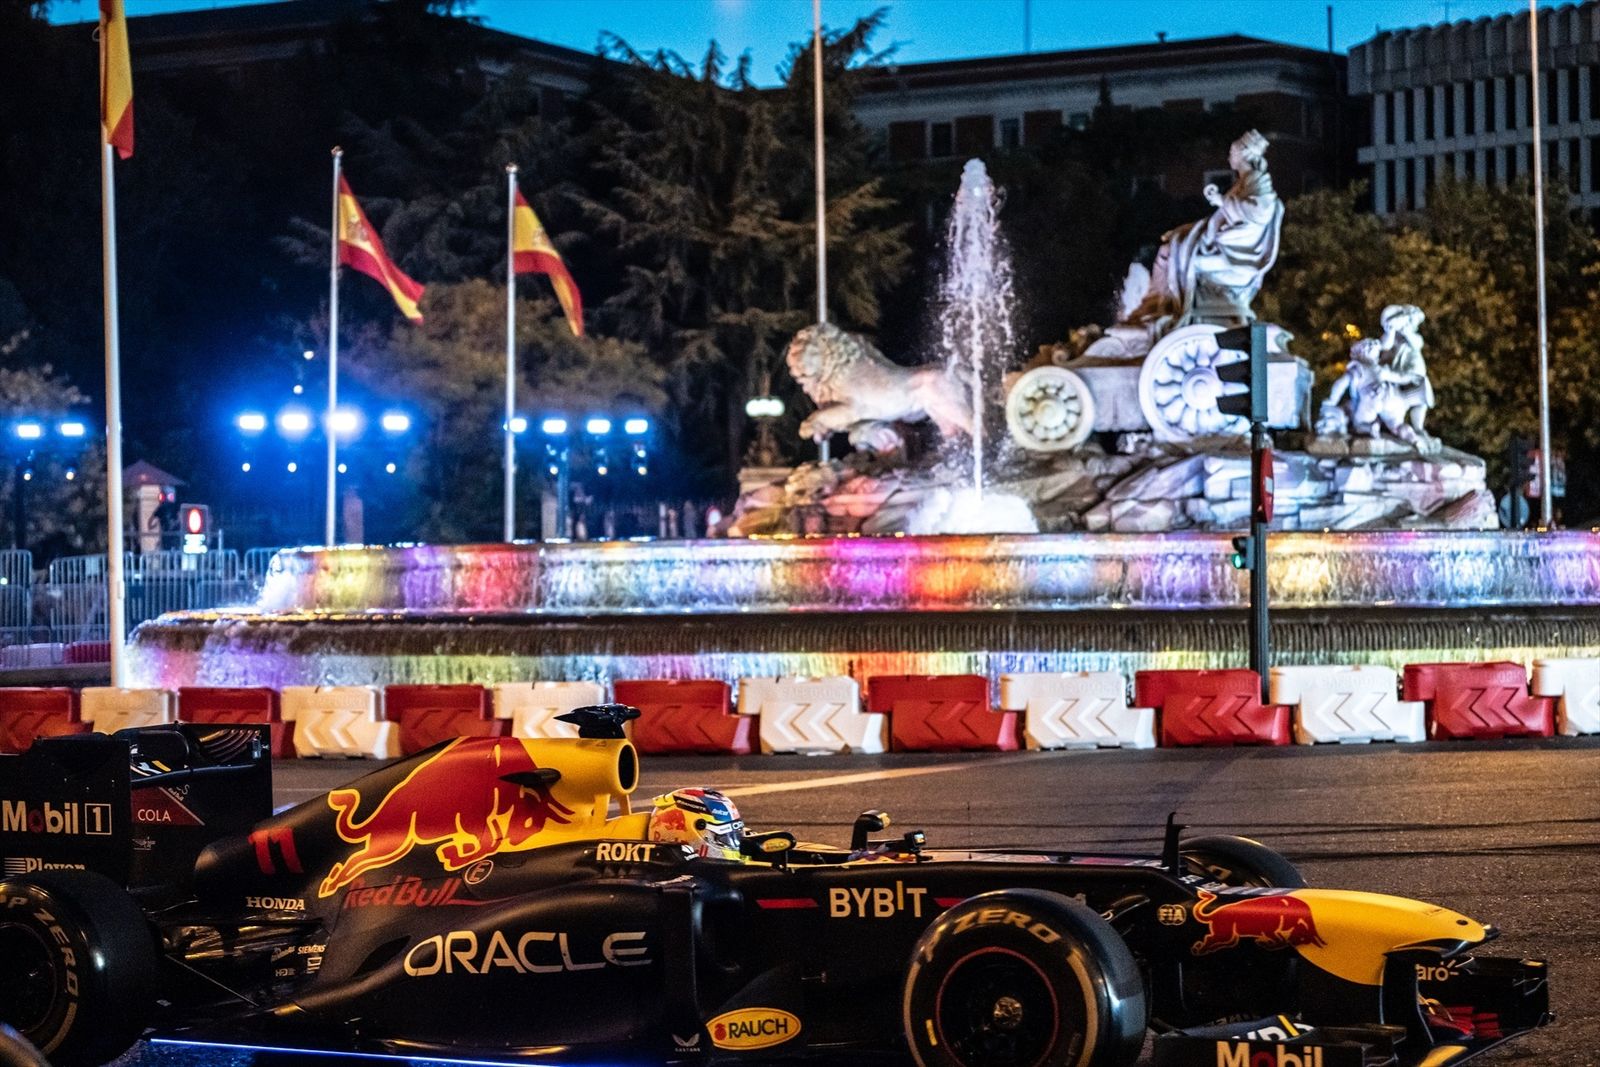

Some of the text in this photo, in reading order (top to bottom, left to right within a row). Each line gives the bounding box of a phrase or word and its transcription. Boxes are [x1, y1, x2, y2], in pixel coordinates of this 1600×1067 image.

[2, 801, 103, 834] Mobil 1
[137, 808, 172, 822] COLA
[248, 827, 304, 874] 11
[596, 843, 656, 862] ROKT
[246, 896, 306, 911] HONDA
[343, 874, 462, 909] Red Bull
[829, 880, 927, 918] BYBIT
[952, 908, 1062, 944] ZERO
[33, 907, 79, 997] ZERO
[404, 930, 653, 977] ORACLE
[728, 1018, 788, 1039] RAUCH
[1216, 1040, 1323, 1067] Mobil
